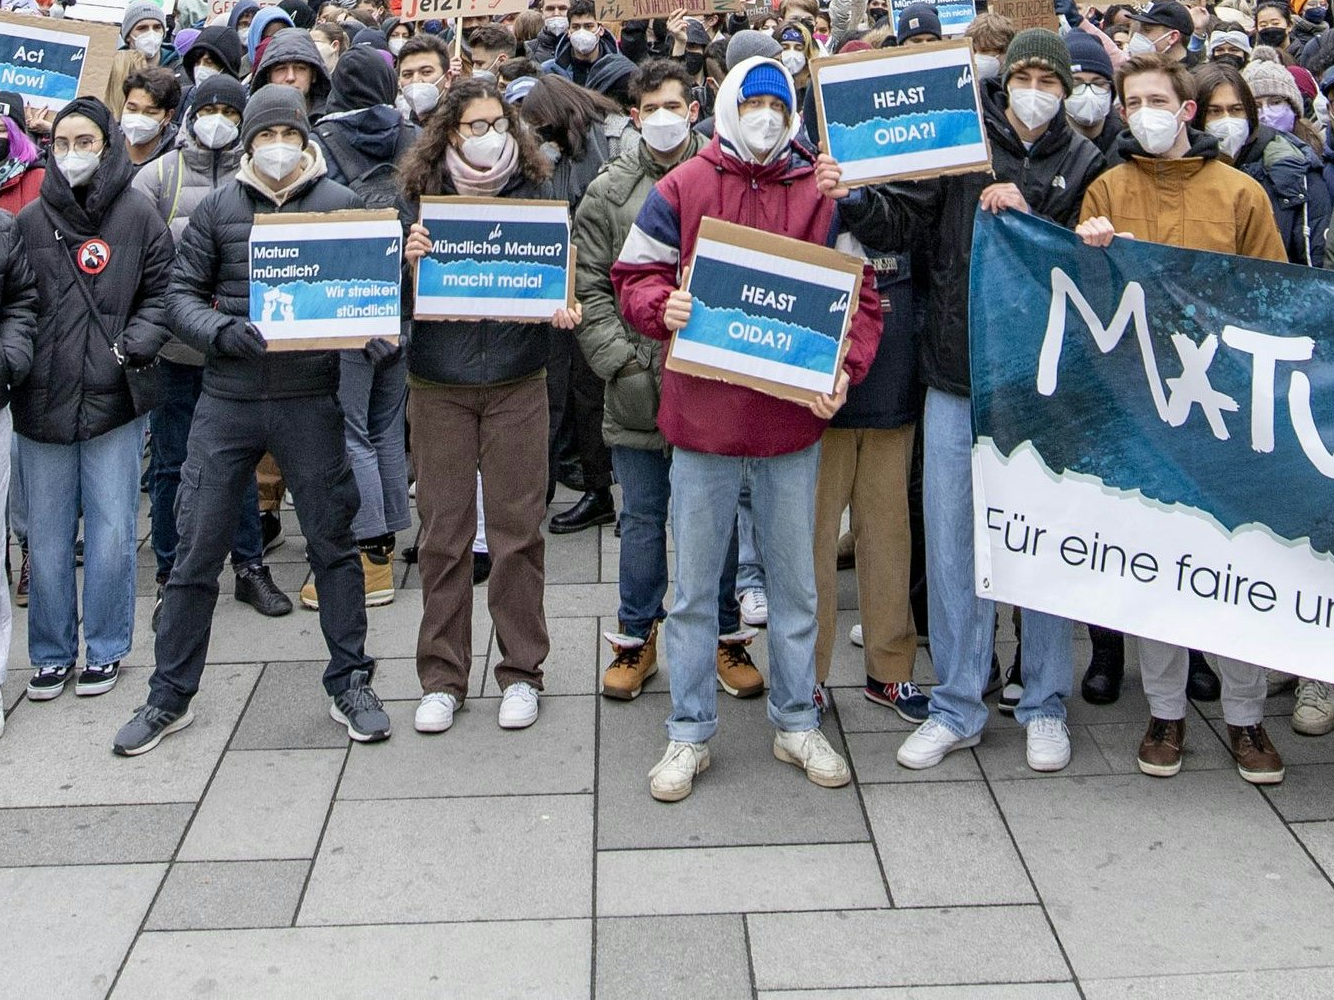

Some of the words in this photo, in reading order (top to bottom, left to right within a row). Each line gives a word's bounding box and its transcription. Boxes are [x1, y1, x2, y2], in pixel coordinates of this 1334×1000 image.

[13, 46, 45, 64] Act
[1, 68, 45, 90] Now!
[873, 86, 925, 109] HEAST
[874, 122, 936, 146] OIDA?!
[253, 246, 299, 259] Matura
[430, 241, 501, 256] Mündliche
[505, 242, 562, 258] Matura?
[253, 264, 320, 279] mündlich?
[442, 272, 495, 289] macht
[325, 285, 353, 298] Wir
[357, 283, 398, 298] streiken
[741, 284, 797, 313] HEAST
[336, 303, 398, 317] stündlich!
[728, 321, 792, 352] OIDA?!
[986, 507, 1047, 557] Für
[1060, 533, 1160, 584] eine
[1175, 543, 1277, 615] faire
